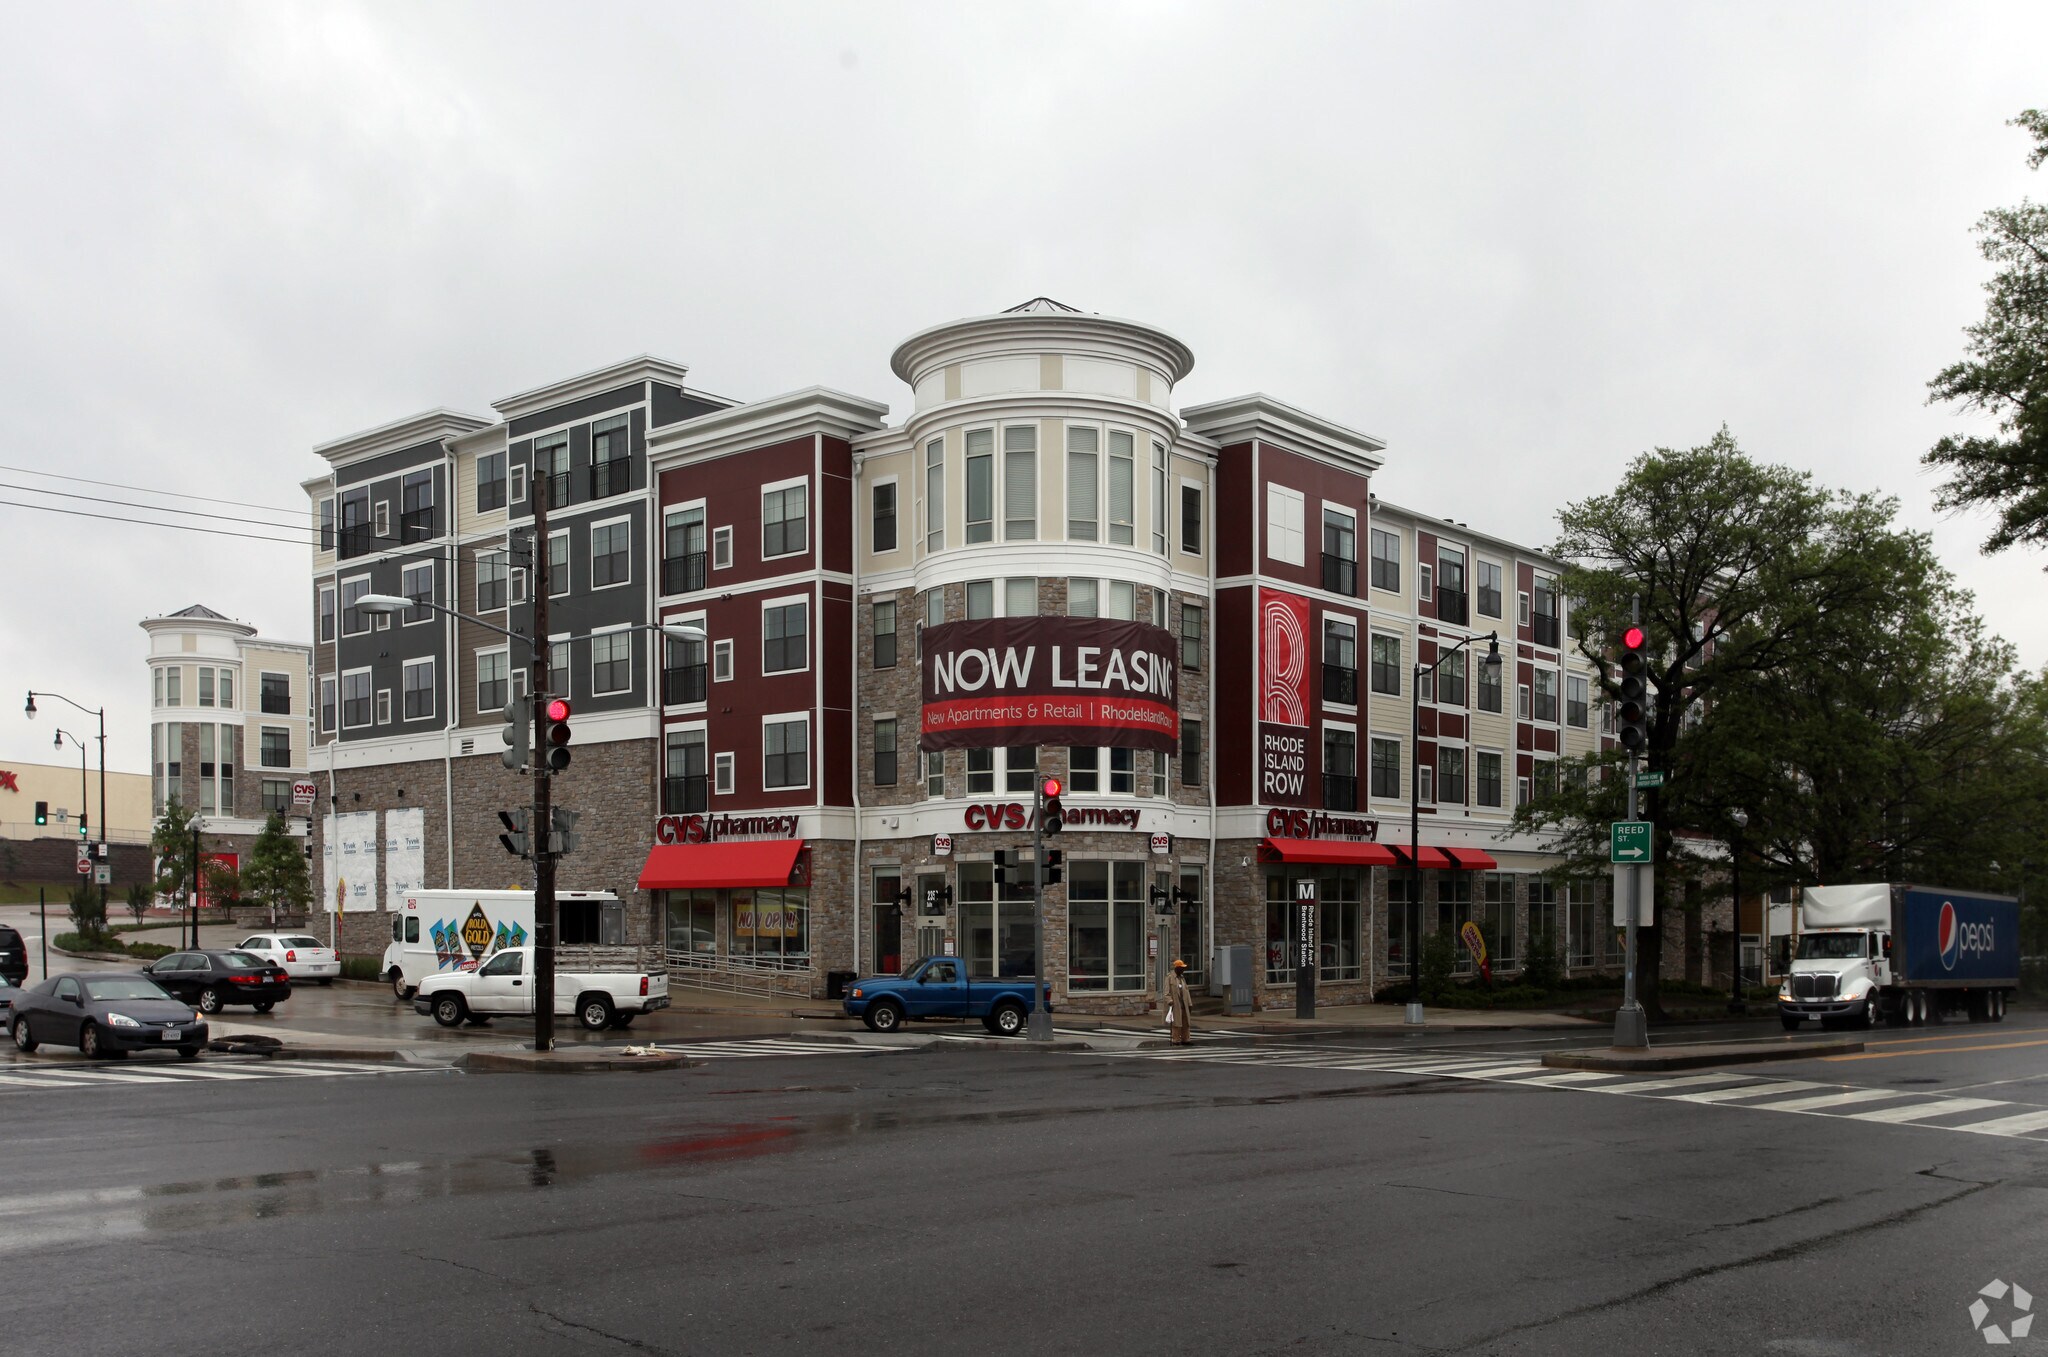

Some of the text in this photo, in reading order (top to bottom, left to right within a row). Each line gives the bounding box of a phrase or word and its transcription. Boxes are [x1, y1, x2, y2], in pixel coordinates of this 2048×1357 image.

[934, 645, 1173, 701] NOW LEASING
[927, 711, 945, 725] New
[947, 705, 1022, 725] Apartments
[1027, 703, 1038, 718] &
[1043, 703, 1083, 718] Retail
[1264, 734, 1304, 754] RHODE
[1264, 752, 1304, 772] ISLAND
[294, 784, 315, 794] CVS
[1264, 771, 1304, 796] ROW
[656, 813, 800, 844] CVS/pharmacy
[1266, 808, 1380, 842] CVS/pharmacy
[1618, 826, 1645, 834] REED
[936, 838, 950, 846] CVS
[1152, 836, 1168, 845] CVS
[1300, 884, 1314, 900] M
[466, 930, 490, 944] GOLD
[1960, 916, 1994, 960] pepsi
